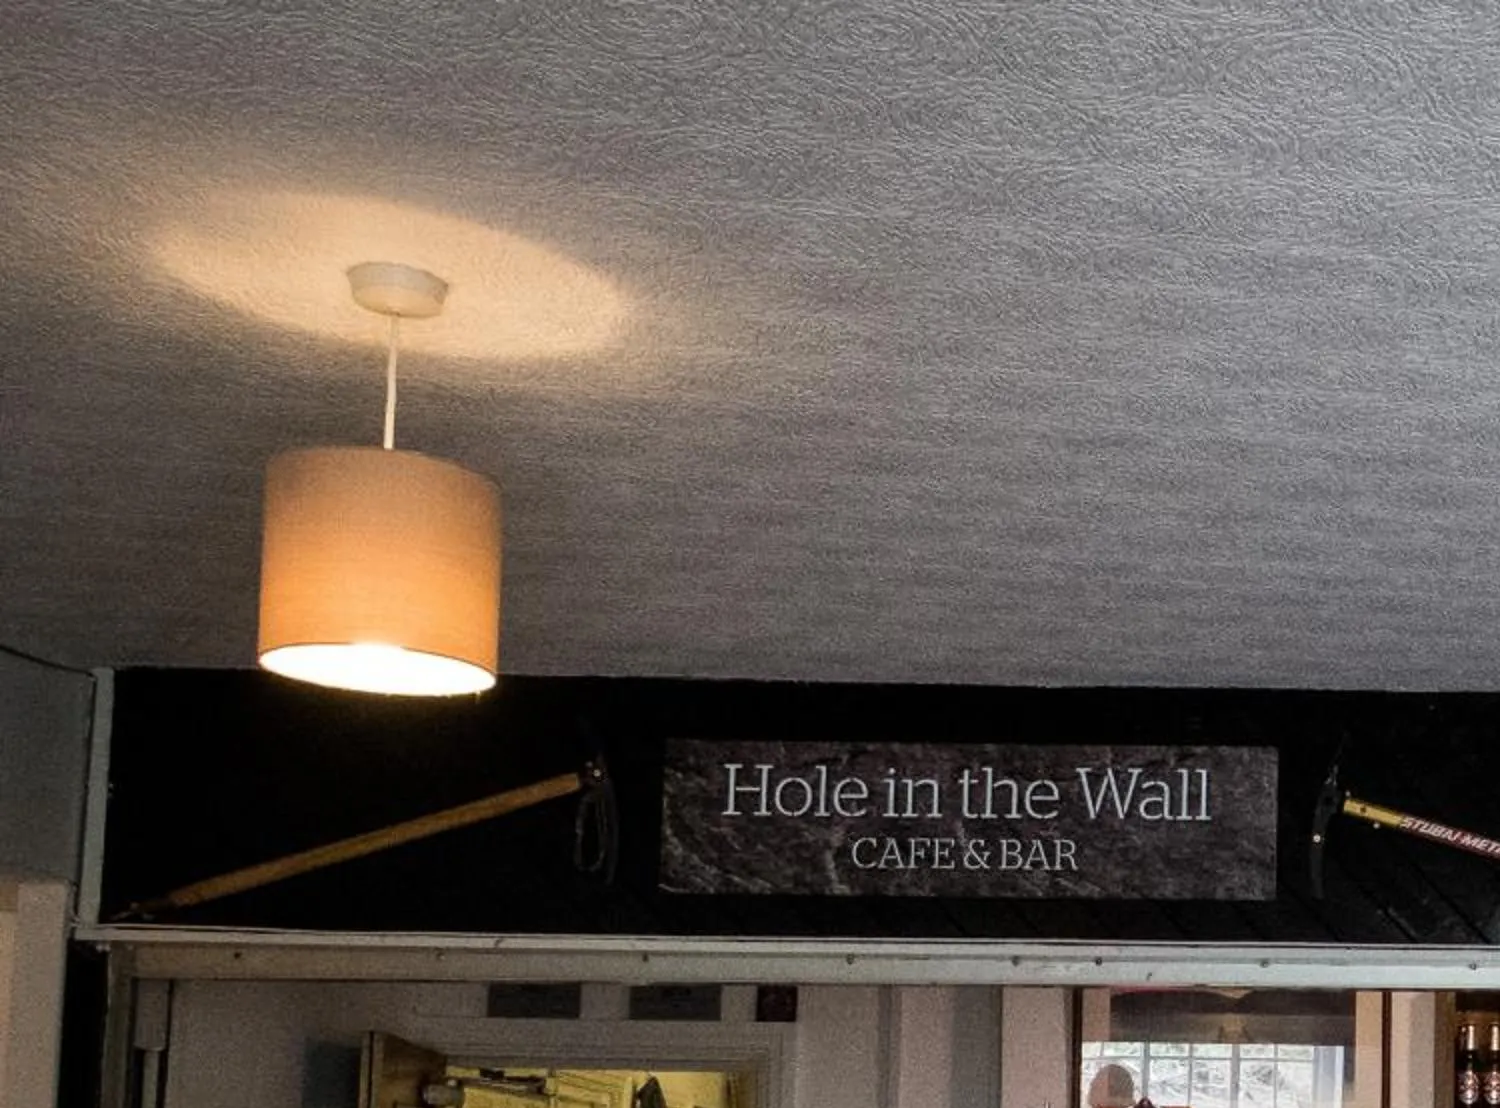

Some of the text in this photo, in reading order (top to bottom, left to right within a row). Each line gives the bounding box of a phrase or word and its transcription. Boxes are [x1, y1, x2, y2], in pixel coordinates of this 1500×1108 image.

[722, 763, 1213, 822] Hole in the Wall
[1400, 816, 1461, 841] STUBAI
[852, 837, 1078, 871] CAFE & BAR
